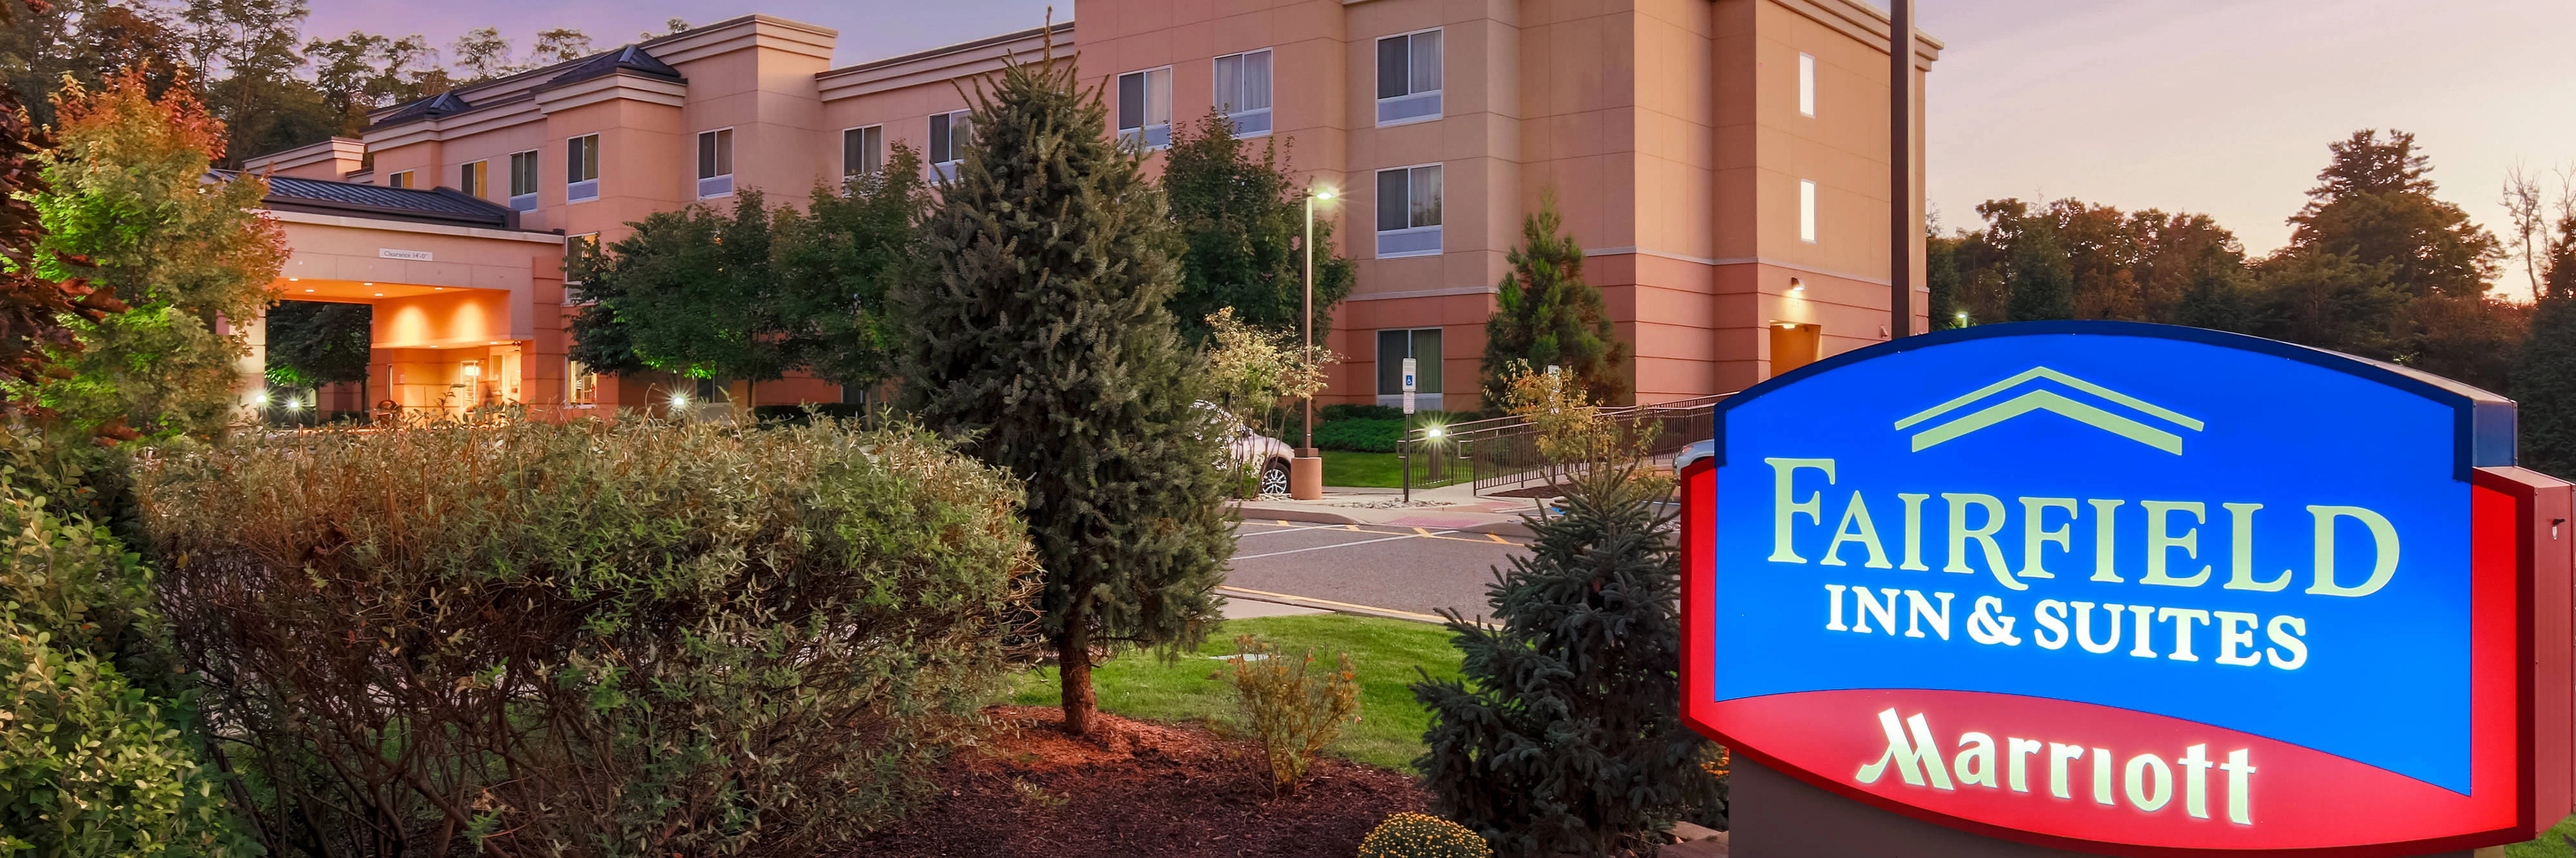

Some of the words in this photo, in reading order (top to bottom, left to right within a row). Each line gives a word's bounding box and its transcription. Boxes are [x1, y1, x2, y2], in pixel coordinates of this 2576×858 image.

[1764, 457, 2401, 597] FAIRFIELD
[1825, 583, 1955, 641] INN
[1966, 595, 2022, 646] &
[2034, 599, 2309, 671] SUITES
[1855, 707, 2258, 826] Marriott
